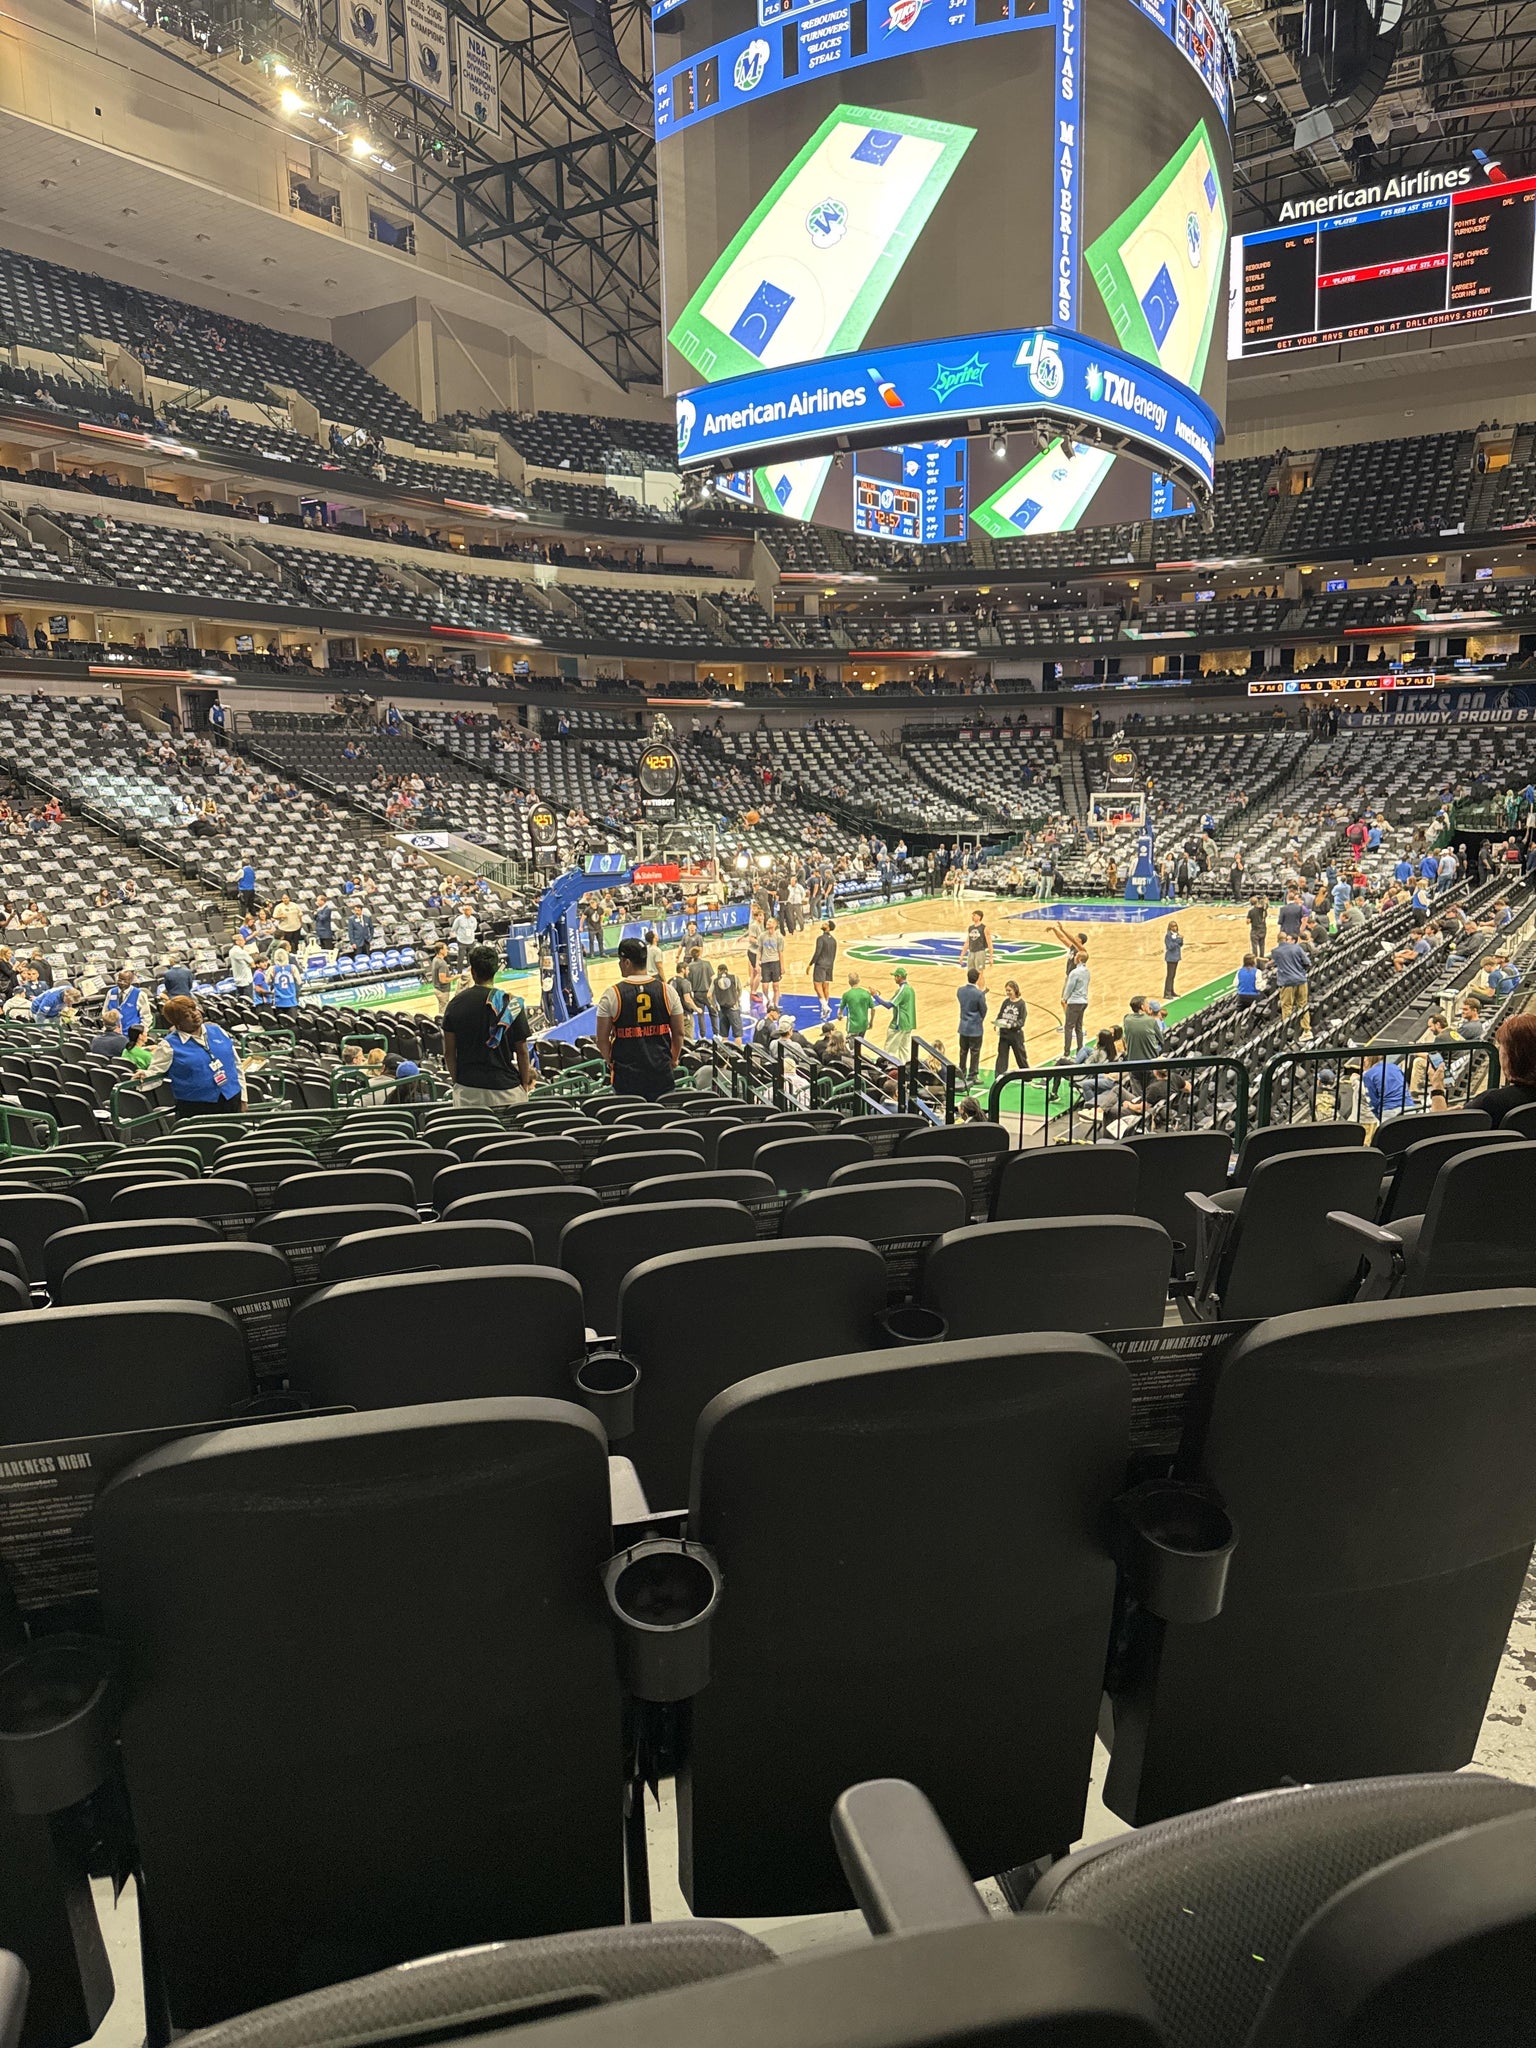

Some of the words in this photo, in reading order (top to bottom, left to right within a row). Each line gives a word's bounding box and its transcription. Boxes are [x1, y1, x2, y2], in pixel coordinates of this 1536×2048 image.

[764, 3, 779, 16] FLS
[801, 8, 848, 30] REBOUNDS
[948, 14, 966, 26] FT
[410, 18, 446, 46] CHAMPIONS
[800, 20, 850, 43] TURNOVERS
[468, 37, 488, 60] NBA
[807, 37, 842, 54] BLOCKS
[466, 51, 491, 72] MIDWEST
[808, 50, 841, 69] STEALS
[466, 62, 492, 83] DIVISION
[463, 69, 497, 96] CHAMPIONS
[469, 82, 491, 101] 1986-87
[1278, 185, 1381, 222] American
[1383, 165, 1472, 201] Airlines
[1058, 121, 1075, 322] MAVERICKS
[1333, 217, 1357, 227] PLAYER
[1380, 209, 1392, 217] PTS
[1393, 207, 1406, 215] REB
[1407, 203, 1420, 212] AST
[1435, 198, 1448, 206] FLS
[1454, 219, 1477, 229] POINTS
[1478, 215, 1492, 223] OFF
[1454, 224, 1487, 237] TURNOVERS
[1331, 275, 1356, 286] PLAYER
[1379, 268, 1391, 276] PTS
[1391, 266, 1405, 274] REB
[1405, 263, 1418, 271] AST
[1420, 261, 1431, 269] STL
[1433, 258, 1446, 266] FLS
[1452, 259, 1475, 269] POINTS
[1451, 282, 1477, 291] LARGEST
[1451, 290, 1477, 300] SCORING
[1478, 287, 1492, 296] RUN
[1245, 305, 1264, 314] POINTS
[1245, 318, 1264, 328] POINTS
[1257, 324, 1273, 333] PAINT
[1277, 341, 1292, 349] GET
[1297, 336, 1317, 345] YOUR
[1322, 332, 1343, 341] MAVS
[1348, 328, 1369, 337] GEAR
[1374, 325, 1385, 333] ON
[1390, 322, 1400, 330] AT
[937, 366, 980, 391] Sprite
[702, 400, 787, 436] American
[787, 386, 866, 418] Airlines
[1103, 371, 1136, 411] TXU
[1133, 393, 1168, 433] energy
[874, 510, 900, 528] 42:57
[1361, 713, 1389, 727] GET
[1394, 711, 1453, 725] ROWDY,
[1458, 709, 1513, 723] PROUD
[1516, 709, 1529, 721] &
[568, 927, 580, 977] CHOCTAW
[636, 993, 652, 1023] 2
[271, 1297, 292, 1309] NIGHT
[1127, 1339, 1160, 1354] HEALTH
[1160, 1335, 1212, 1351] AWARENESS
[57, 1453, 93, 1472] NIGHT
